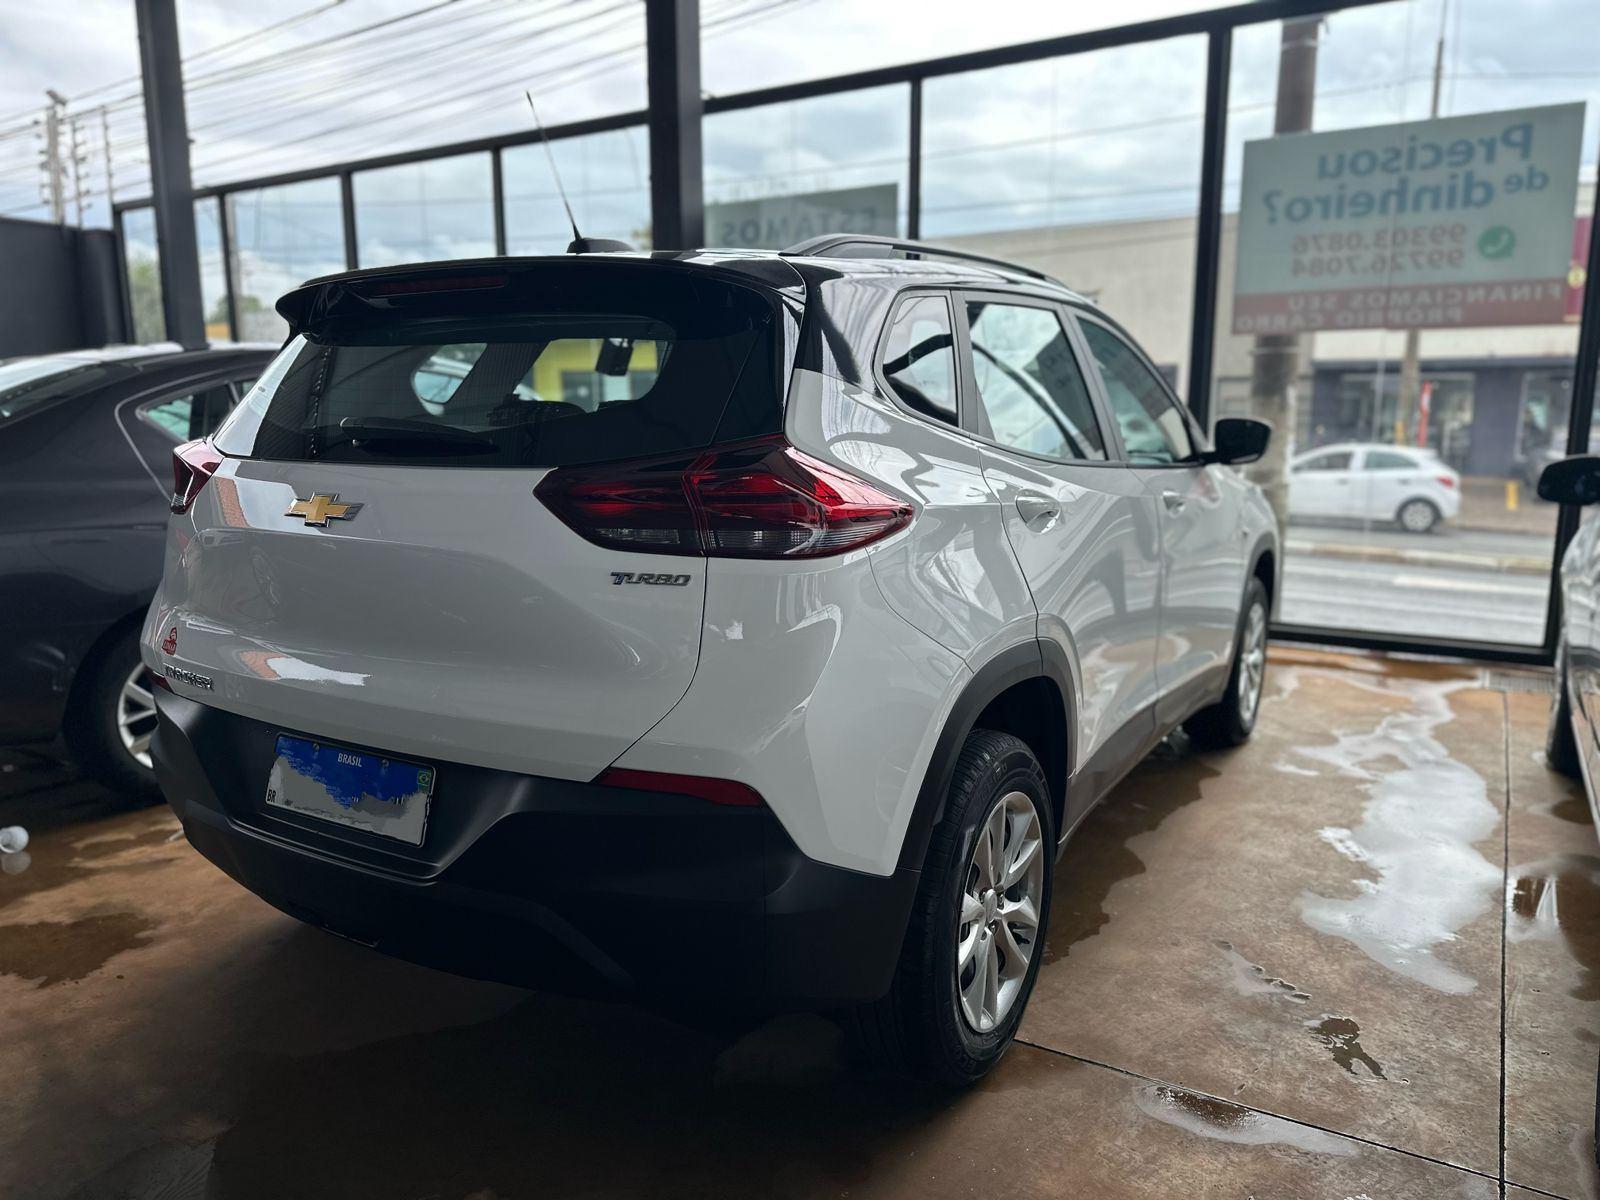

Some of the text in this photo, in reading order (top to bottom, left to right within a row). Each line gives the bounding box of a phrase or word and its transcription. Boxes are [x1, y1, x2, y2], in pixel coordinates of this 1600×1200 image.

[610, 571, 691, 586] TURBO
[163, 664, 214, 692] TRACKER
[337, 753, 363, 768] BRASIL
[266, 789, 276, 803] BR
